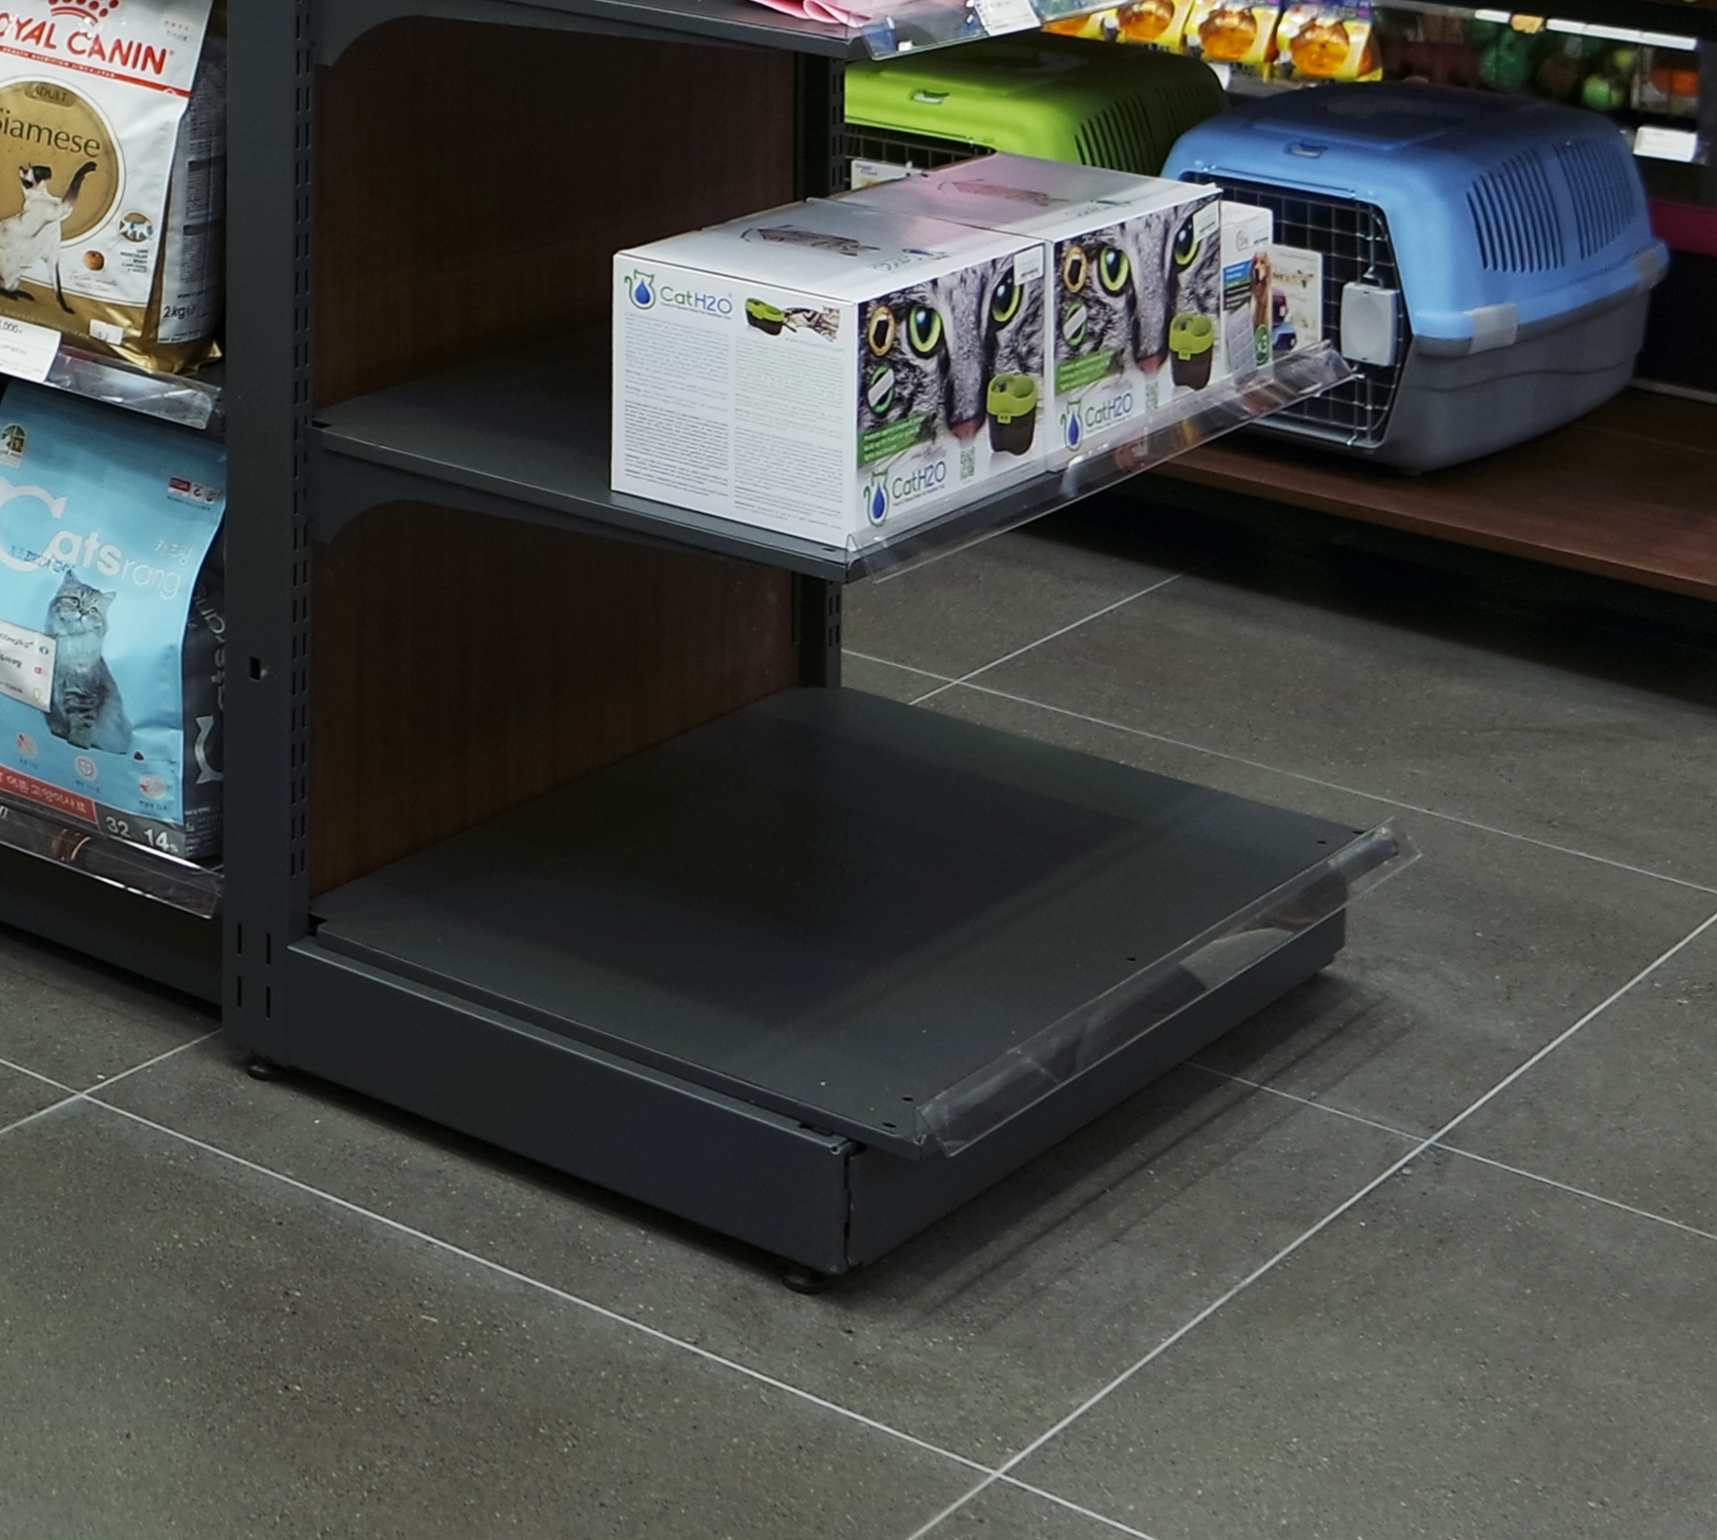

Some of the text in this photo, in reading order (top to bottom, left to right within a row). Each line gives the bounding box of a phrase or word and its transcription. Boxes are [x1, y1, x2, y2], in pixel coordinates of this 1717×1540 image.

[66, 31, 168, 75] CANIN
[31, 85, 68, 102] ADULT
[660, 286, 732, 315] CatH2O
[1085, 393, 1133, 428] CatH2O
[892, 461, 946, 500] CatH2O
[106, 816, 129, 839] 32
